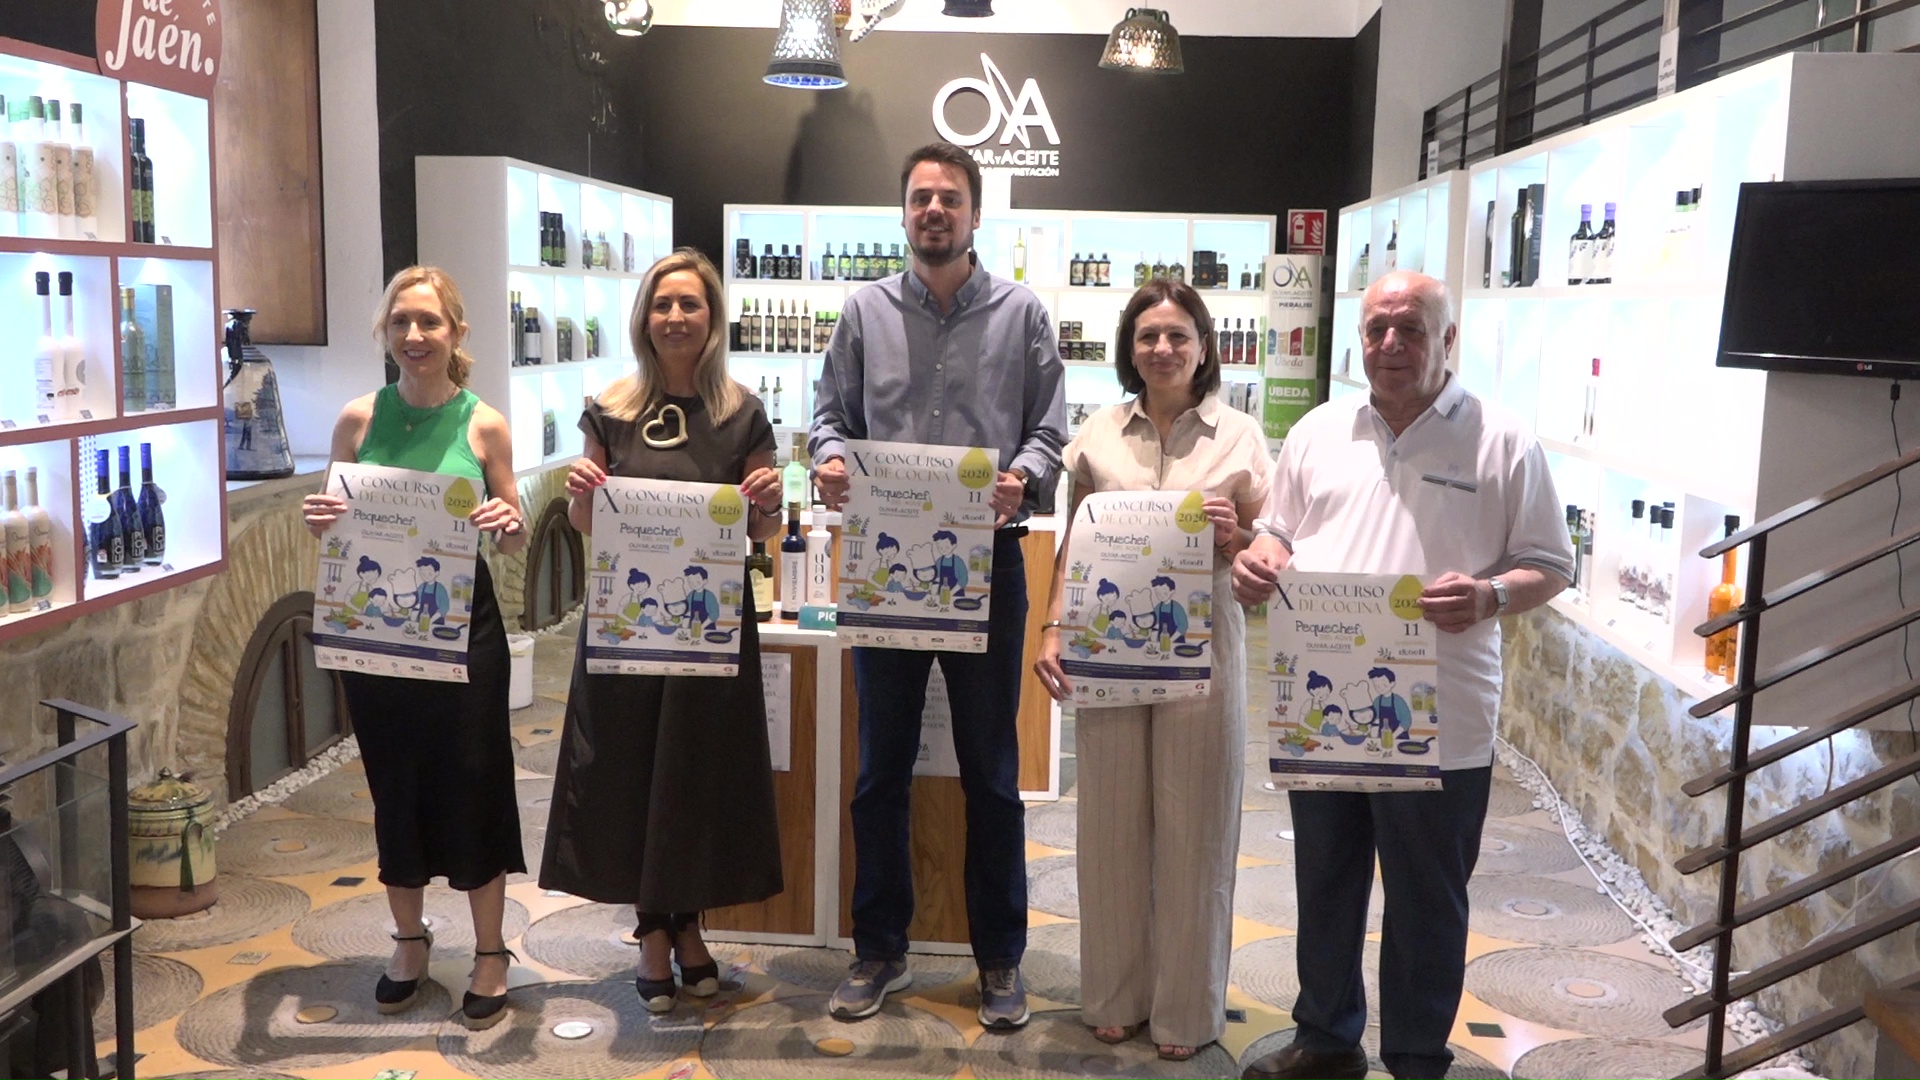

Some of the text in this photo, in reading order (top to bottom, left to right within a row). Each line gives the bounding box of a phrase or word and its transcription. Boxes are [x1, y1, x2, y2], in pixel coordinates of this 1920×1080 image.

[105, 0, 214, 76] Jaén.
[1001, 149, 1060, 165] ACEITE
[1268, 383, 1311, 398] ÚBEDA
[851, 451, 954, 477] X CONCURSO
[874, 467, 951, 484] DE COCINA
[960, 469, 990, 479] 2026
[336, 474, 440, 499] X CONCURSO
[871, 485, 930, 502] Pequechef
[358, 491, 437, 511] DE COCINA
[447, 497, 475, 509] 2026
[599, 488, 705, 514] X CONCURSO
[968, 491, 981, 503] 11
[353, 508, 416, 526] Pequechef
[624, 503, 701, 519] DE COCINA
[711, 504, 740, 516] 2026
[1080, 501, 1173, 524] X CONCURSO
[452, 520, 466, 533] 11
[1100, 513, 1169, 528] DE COCINA
[620, 523, 680, 539] Pequechef
[719, 528, 732, 540] 11
[1094, 532, 1150, 547] Pequechef
[1185, 535, 1199, 548] 11
[1274, 582, 1385, 610] X CONCURSO
[1394, 599, 1418, 609] 202
[1299, 600, 1383, 614] DE COCINA
[1295, 620, 1360, 637] Pequechef
[1404, 623, 1419, 636] 11
